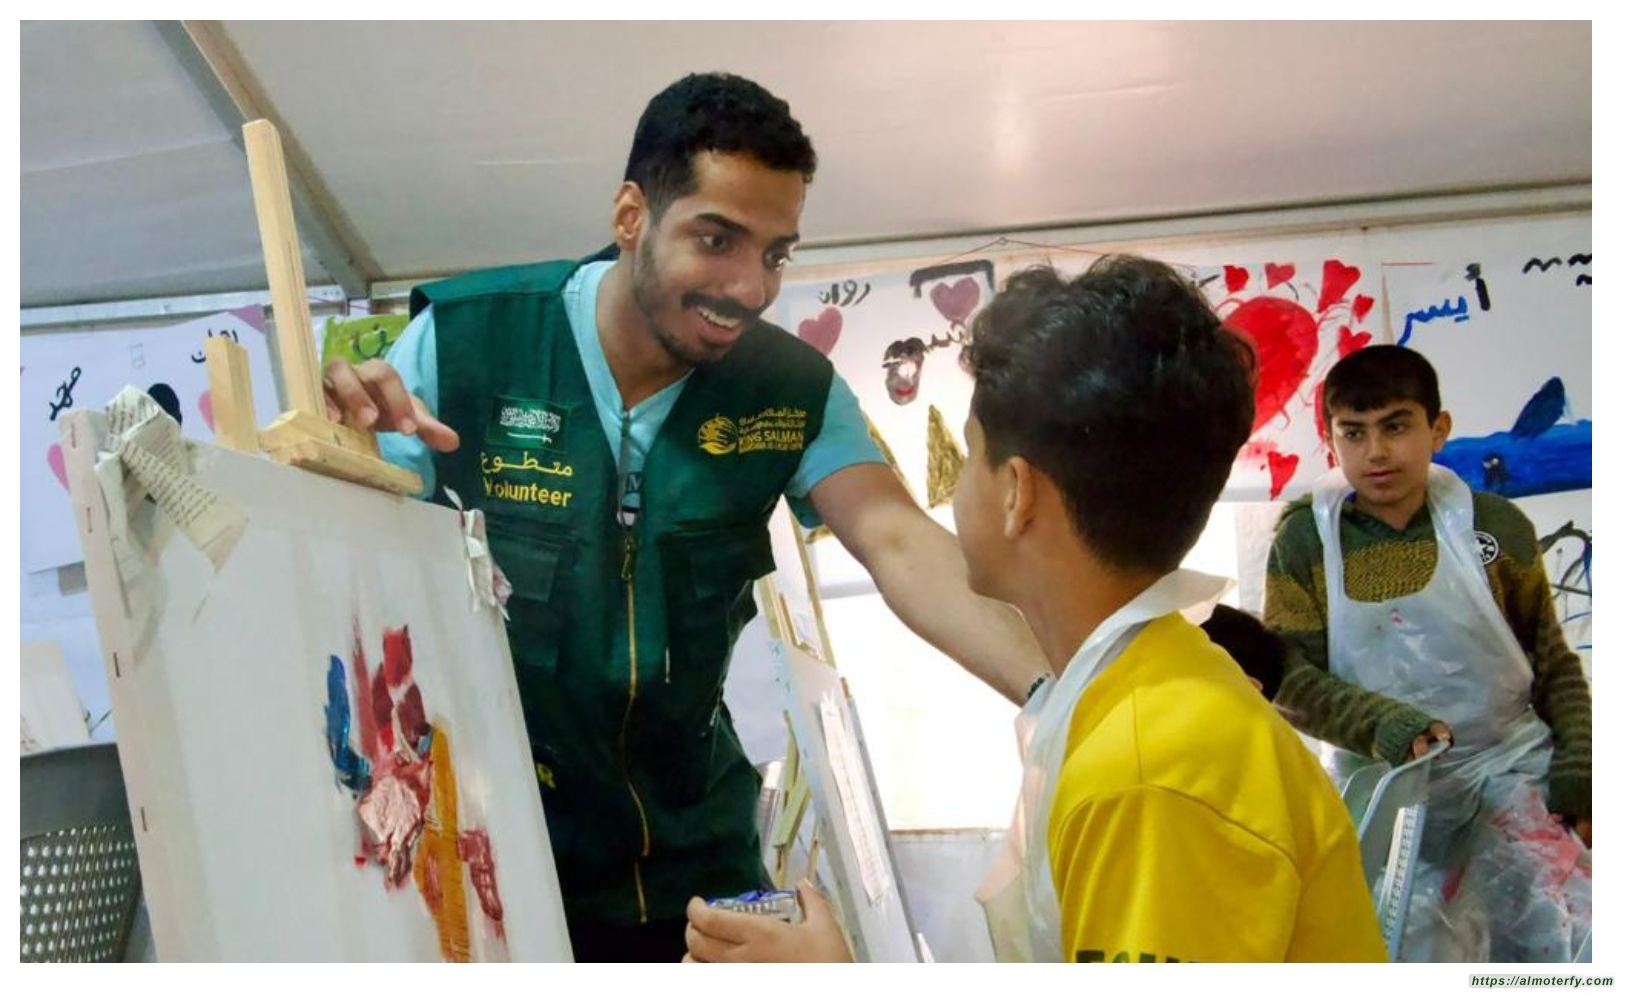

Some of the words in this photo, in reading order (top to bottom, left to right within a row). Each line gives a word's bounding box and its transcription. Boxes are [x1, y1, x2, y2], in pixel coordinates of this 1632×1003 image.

[764, 429, 805, 443] SALMAN
[480, 451, 573, 477] متطوع
[483, 476, 573, 507] Volunteer
